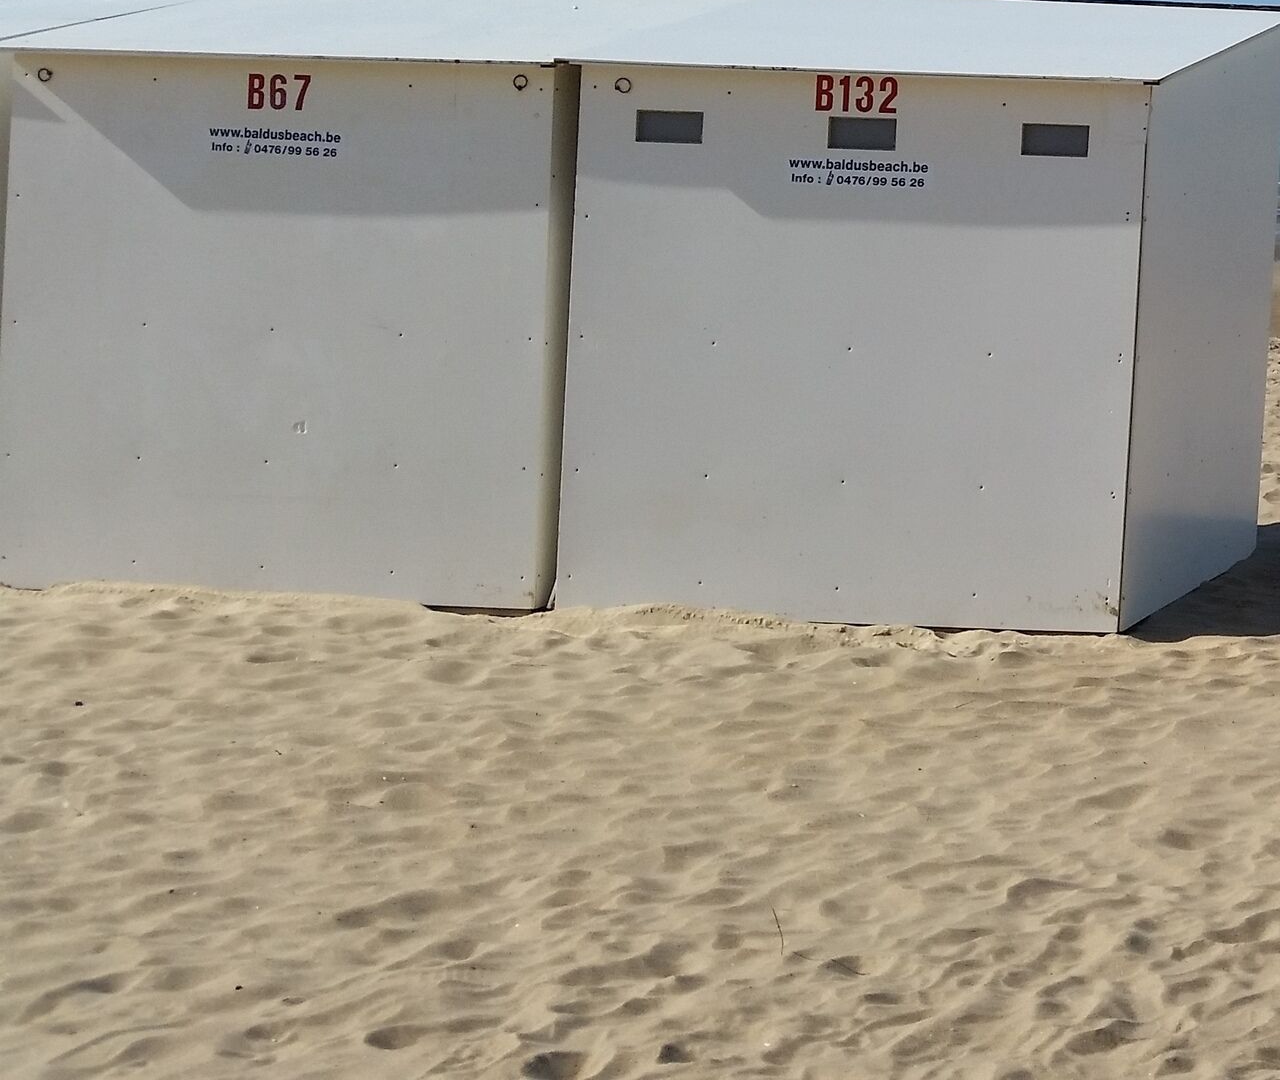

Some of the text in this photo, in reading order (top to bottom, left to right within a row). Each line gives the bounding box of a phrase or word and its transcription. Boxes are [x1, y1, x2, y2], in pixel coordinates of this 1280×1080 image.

[247, 73, 312, 111] B67
[815, 74, 899, 114] B132
[209, 127, 341, 143] www.baldusbeach.be
[211, 142, 233, 152] Info
[254, 144, 302, 156] 0476/99
[305, 147, 320, 157] 56
[323, 148, 337, 158] 26
[789, 158, 929, 173] www.baldusbeach.be
[791, 173, 815, 184] Info
[836, 175, 888, 187] 0476/99
[891, 177, 906, 187] 56
[909, 178, 925, 188] 26
